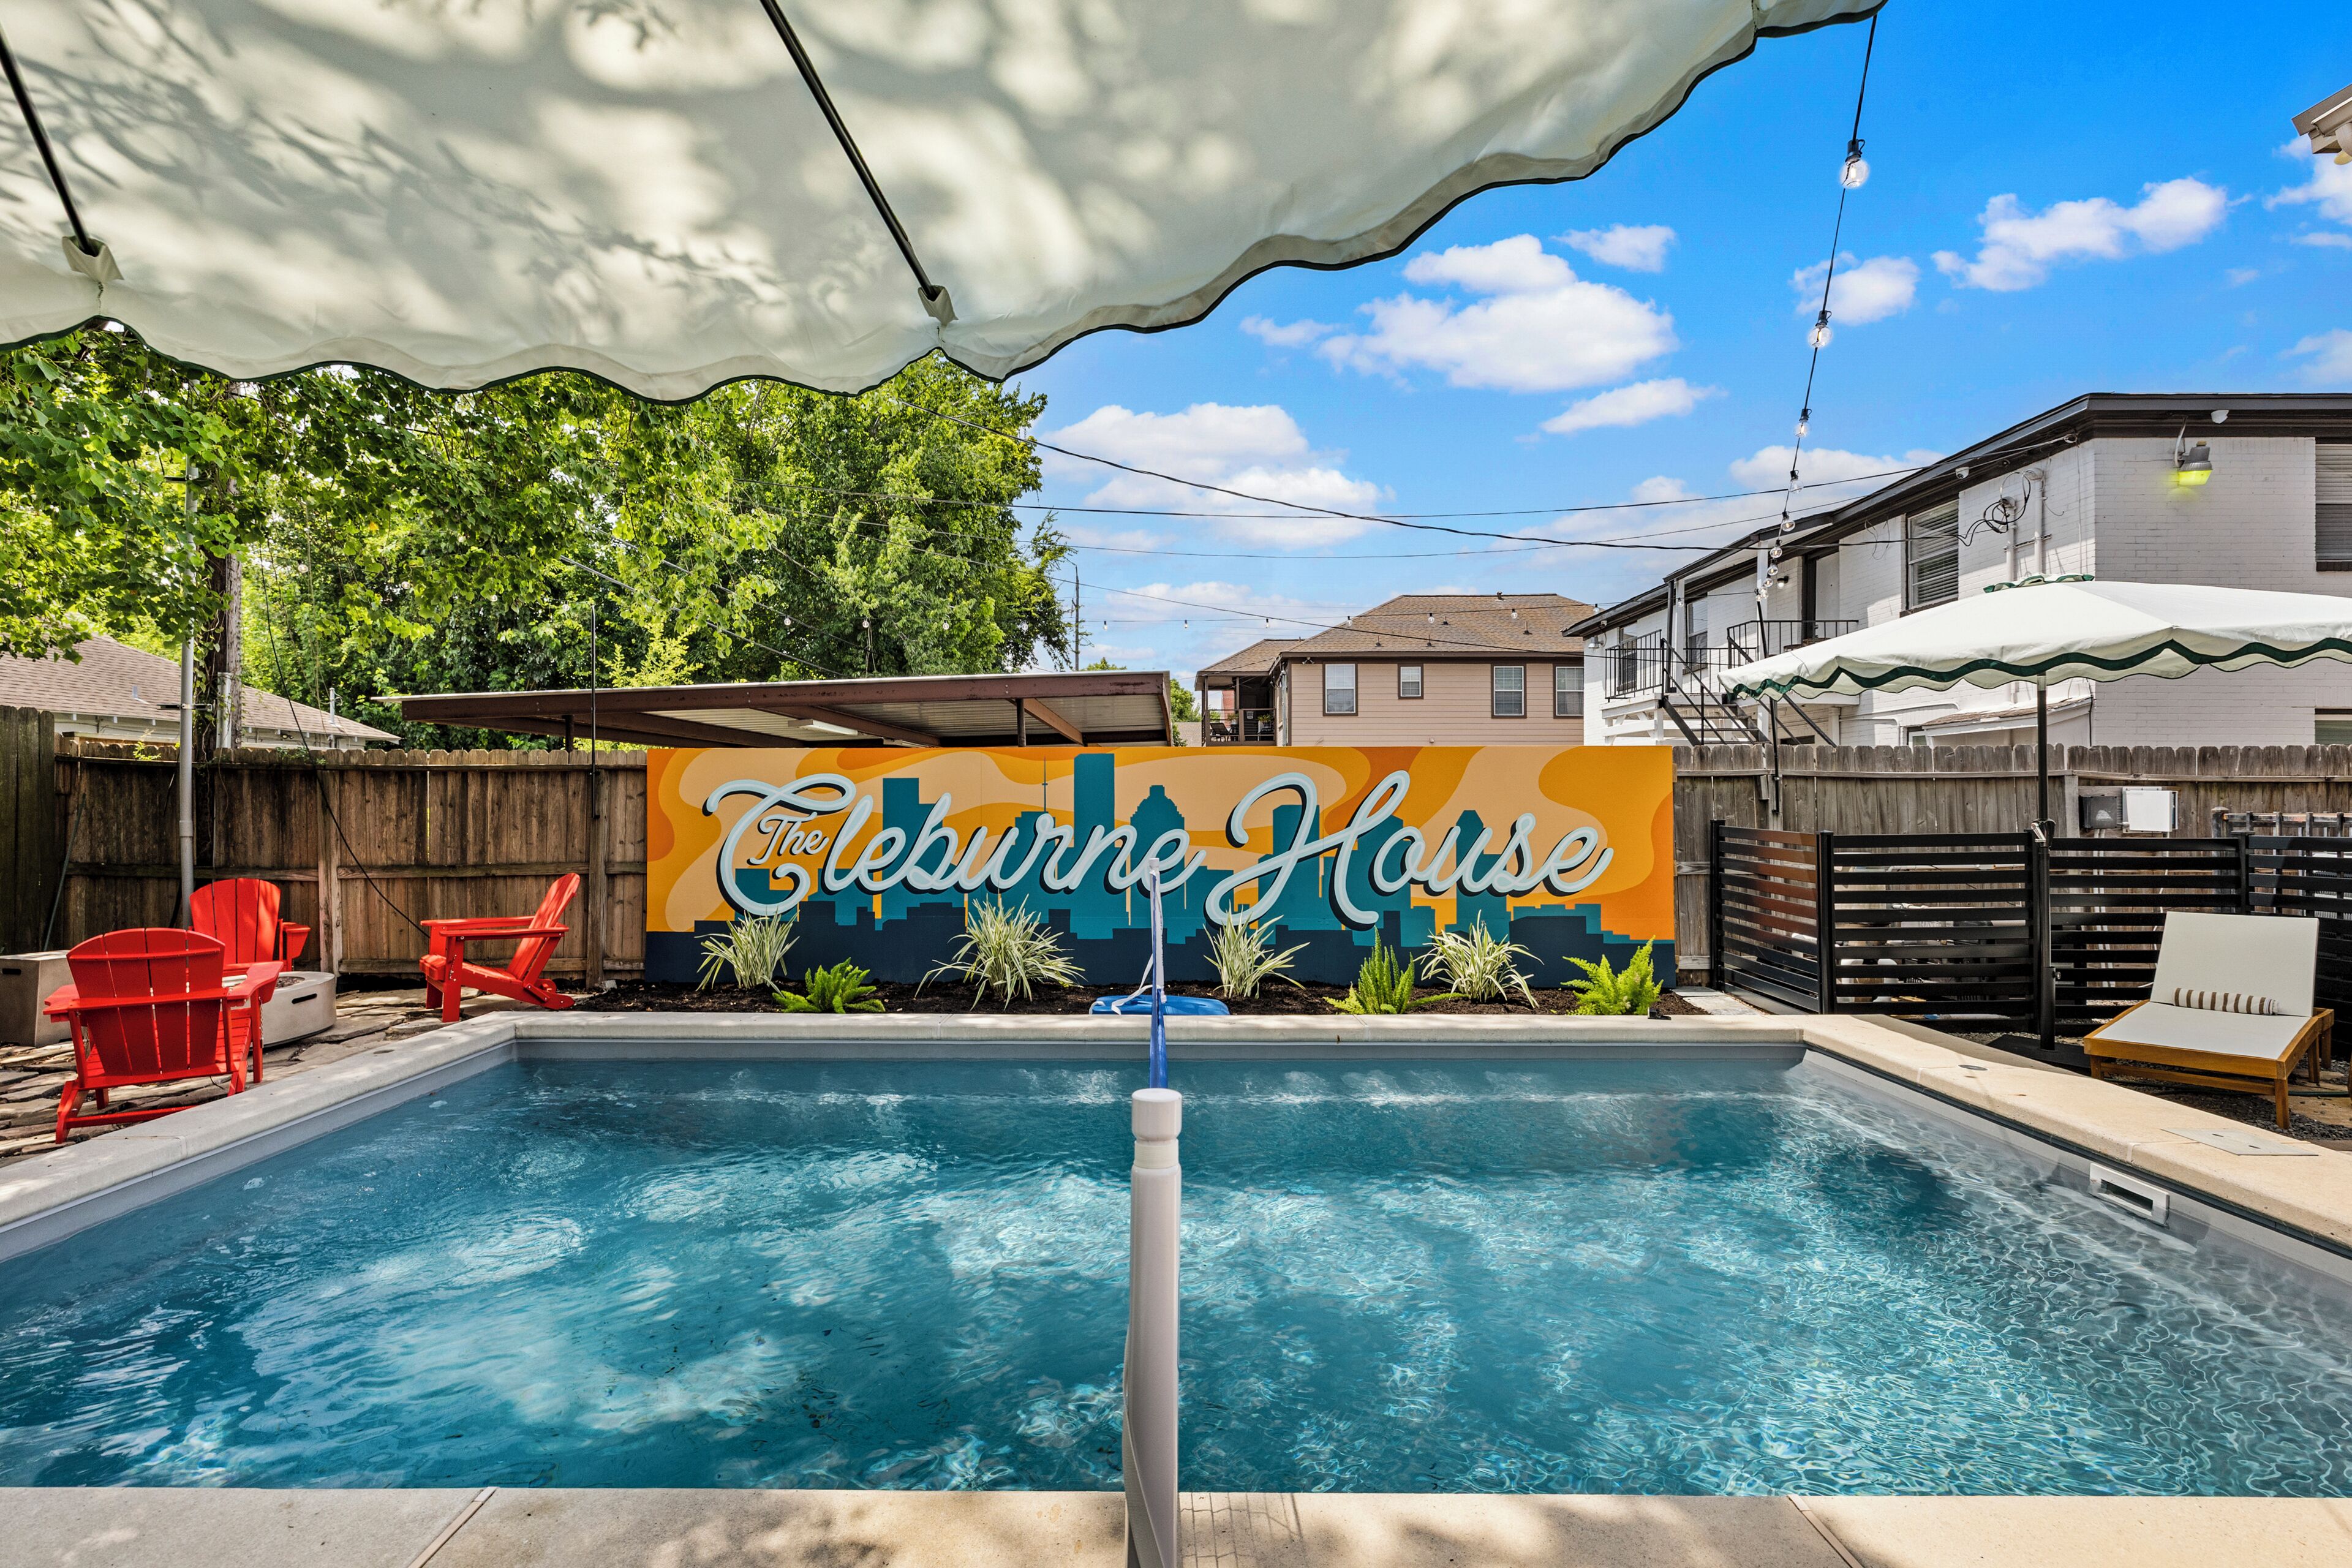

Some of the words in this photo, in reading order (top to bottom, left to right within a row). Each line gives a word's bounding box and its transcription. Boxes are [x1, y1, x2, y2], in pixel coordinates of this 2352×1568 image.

[703, 773, 1207, 916] Cleburne
[747, 812, 829, 865] The
[1204, 771, 1614, 929] House
